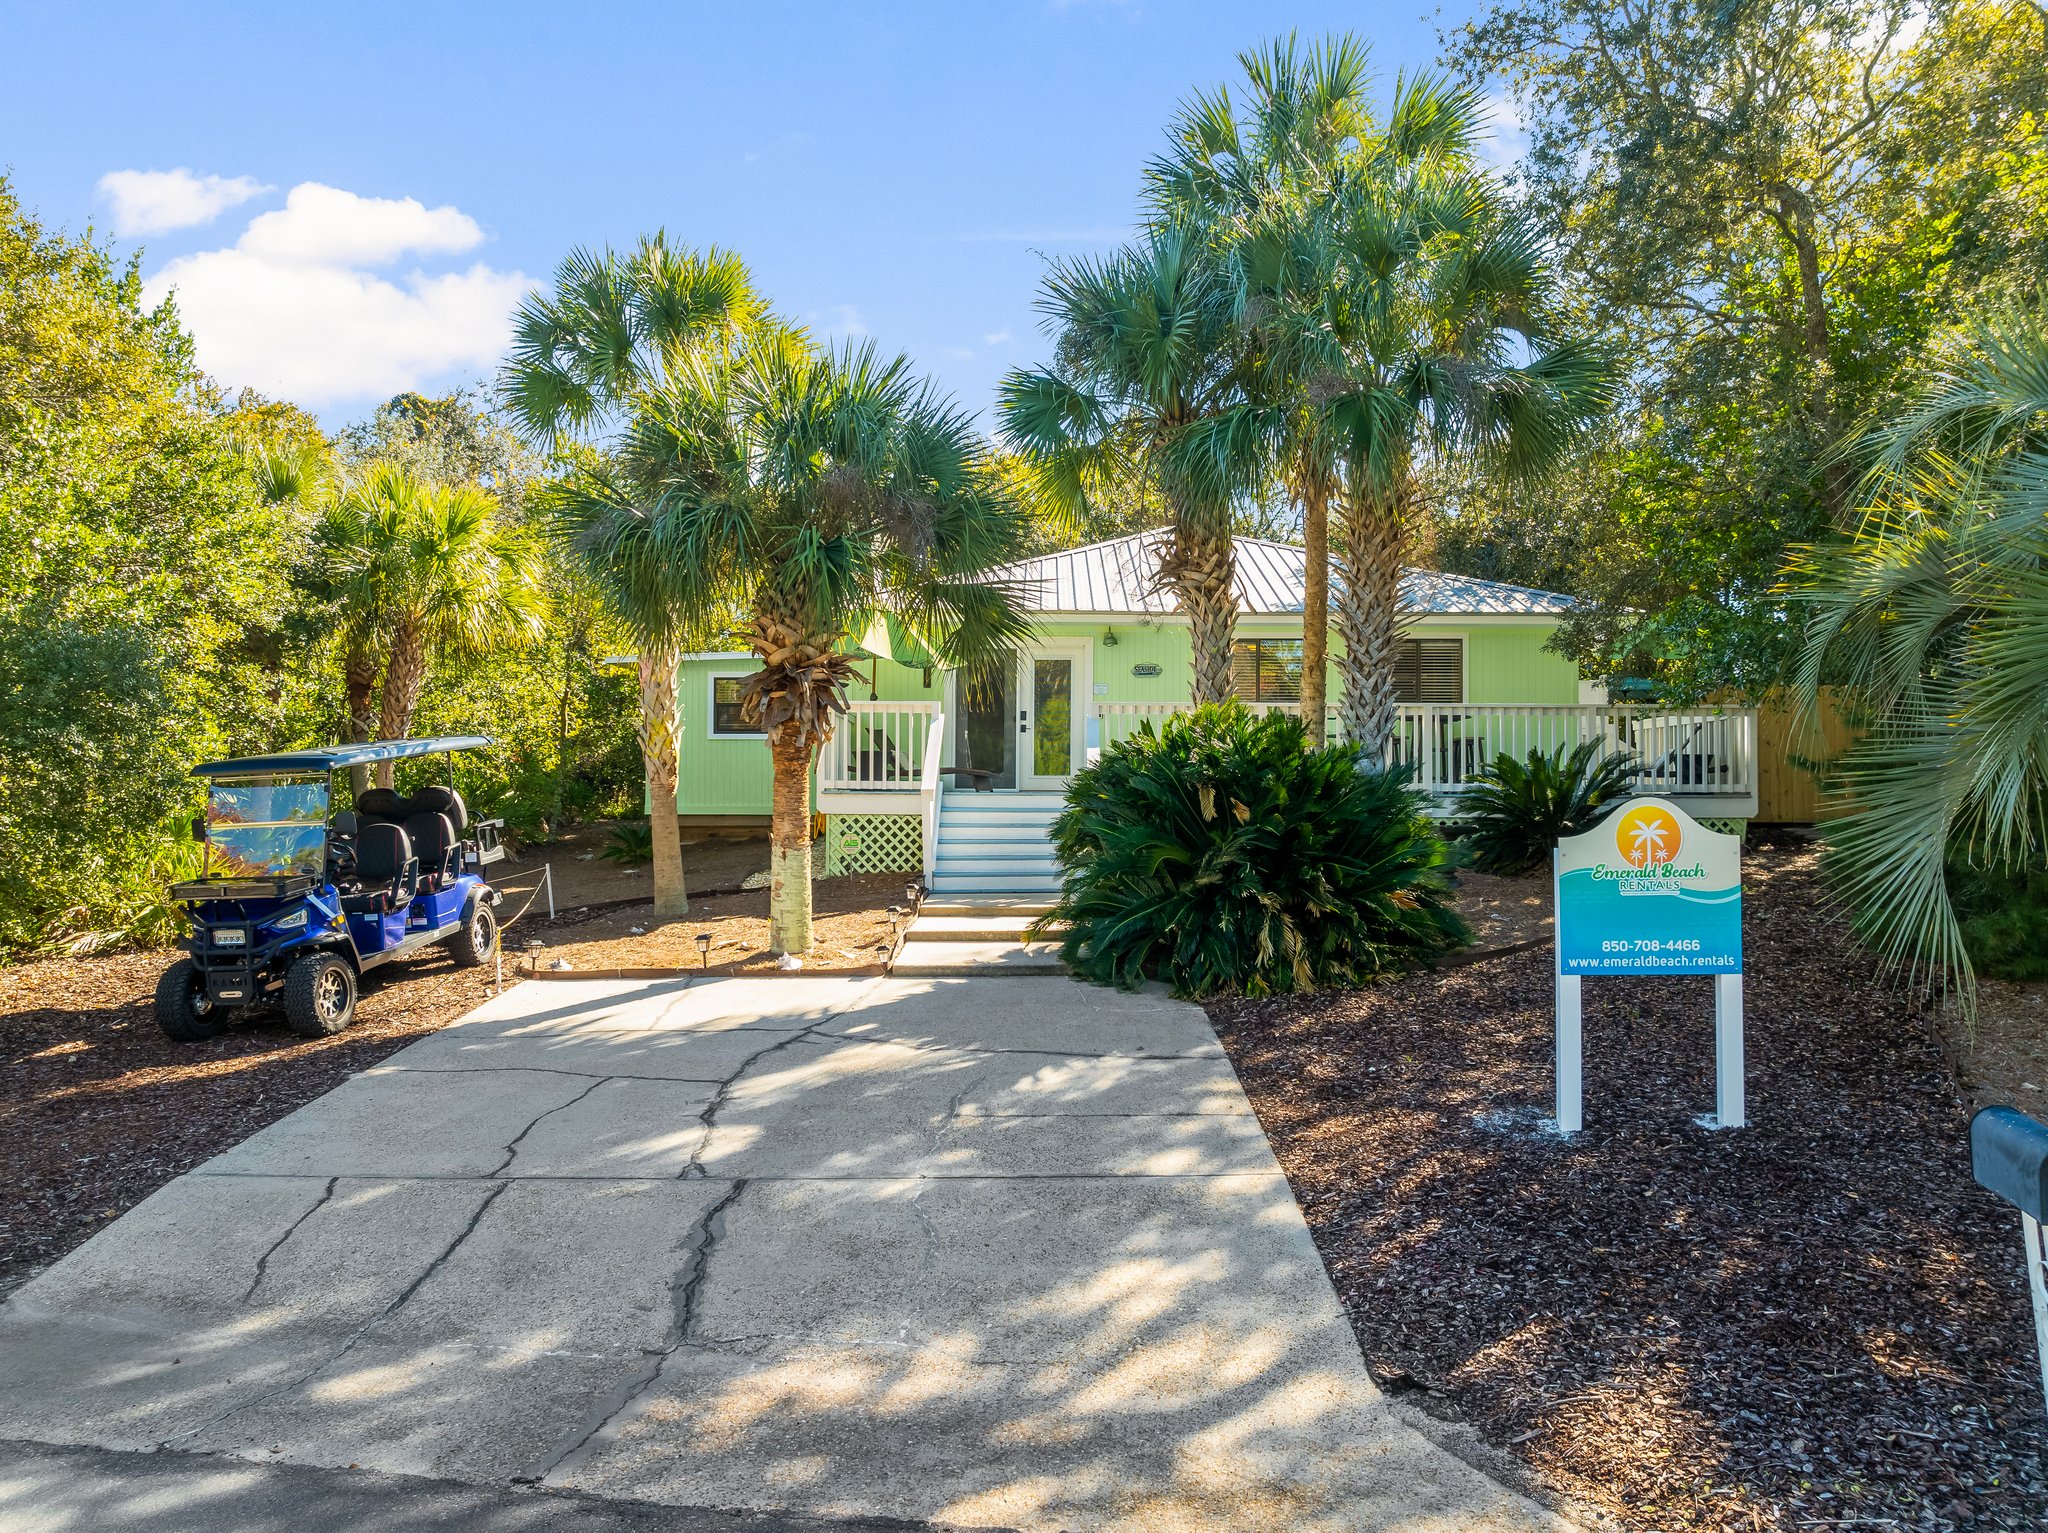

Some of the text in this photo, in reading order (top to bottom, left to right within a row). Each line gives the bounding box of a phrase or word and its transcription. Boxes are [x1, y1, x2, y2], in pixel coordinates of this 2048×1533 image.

[1592, 862, 1705, 879] Emerald Beach
[1620, 880, 1680, 890] RENTALS
[1602, 940, 1700, 952] 850-708-4466
[1568, 954, 1735, 967] www.emeraldbeach.rentals
